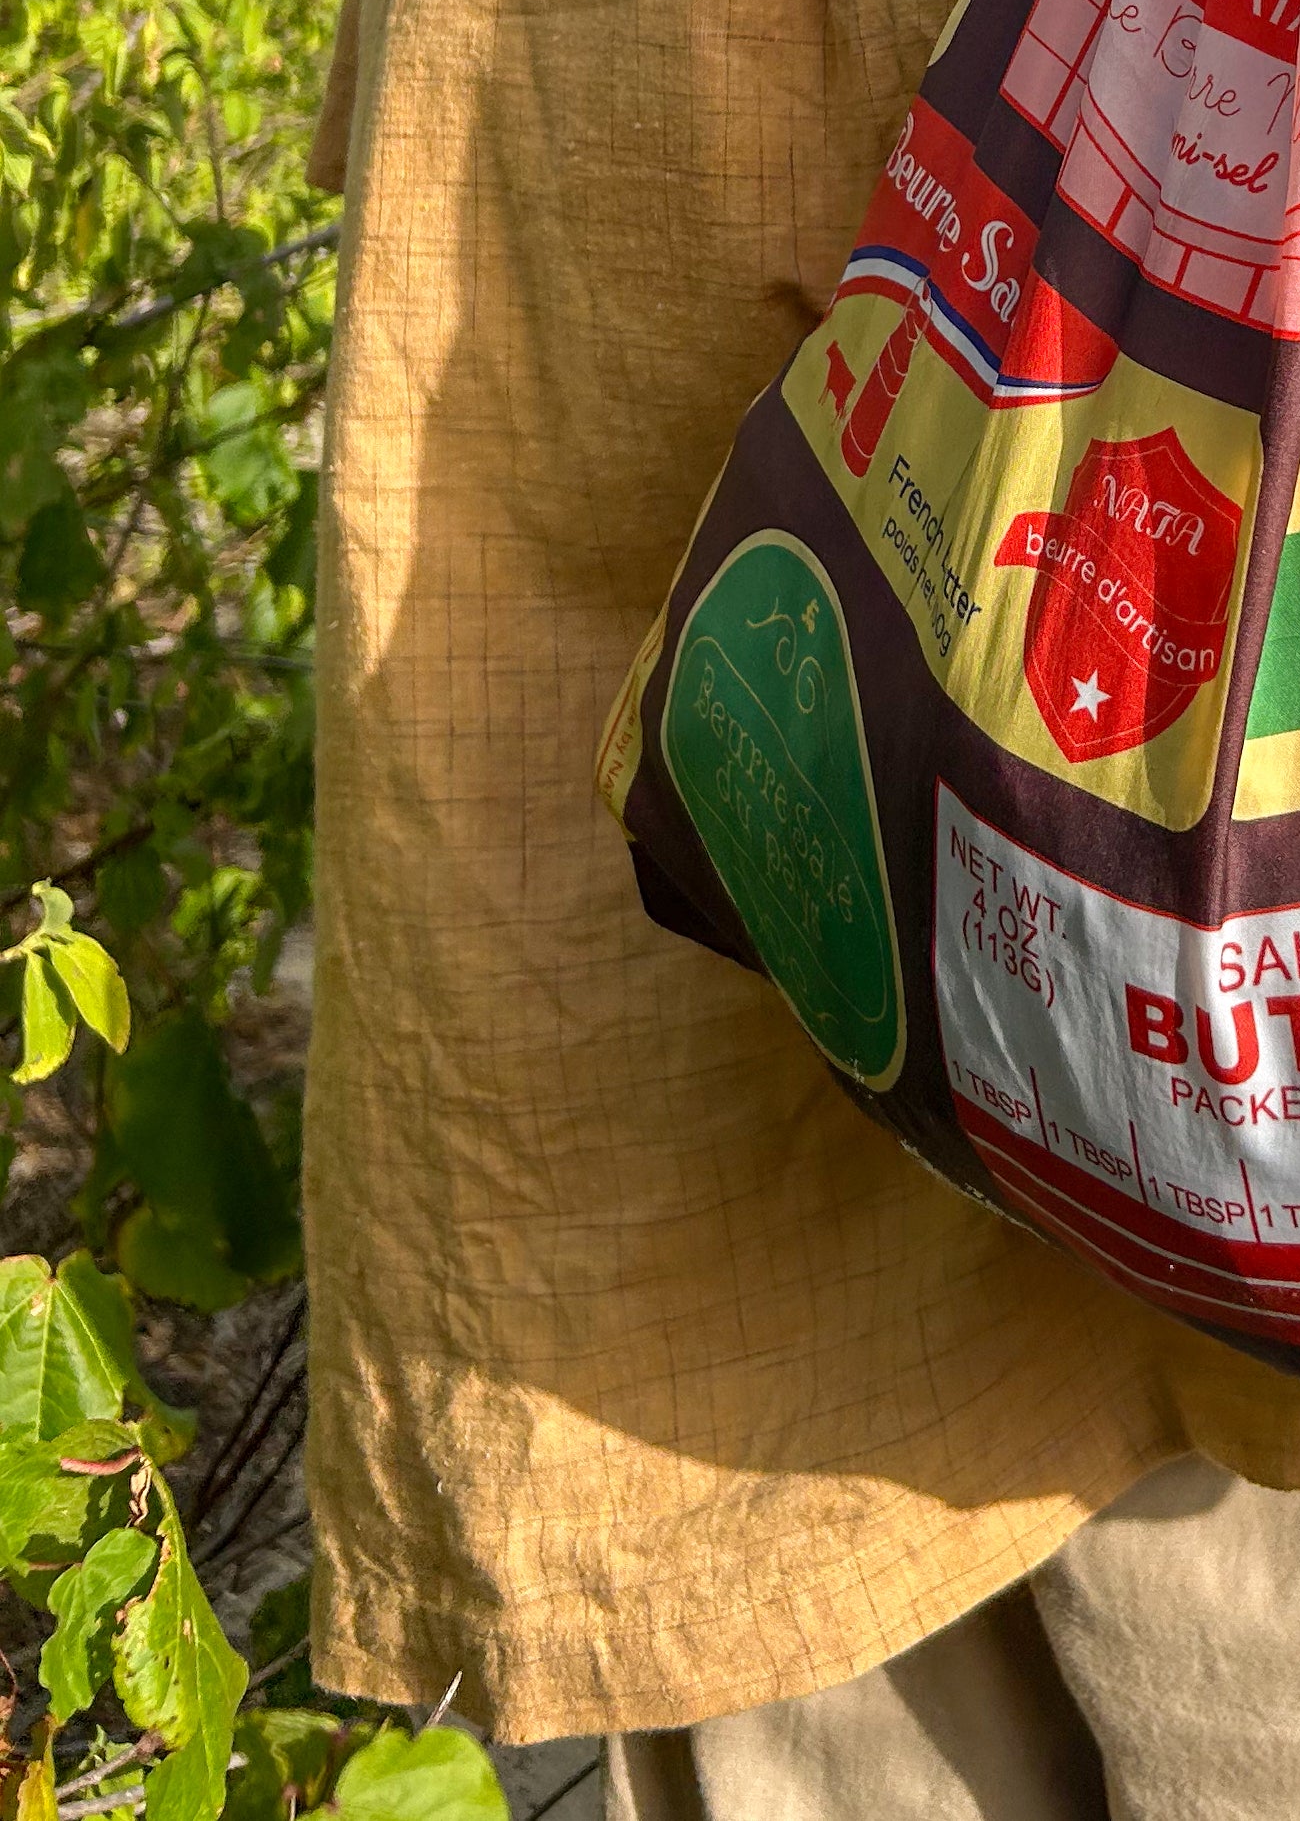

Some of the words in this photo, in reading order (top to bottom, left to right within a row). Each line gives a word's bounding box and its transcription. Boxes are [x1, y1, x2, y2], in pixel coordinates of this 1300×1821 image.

[961, 220, 1021, 329] Sa
[888, 453, 944, 556] French
[1093, 474, 1205, 556] NATA
[881, 517, 920, 574] poids
[1098, 578, 1214, 672] d'artisan
[952, 826, 1003, 893] NET
[1012, 877, 1066, 939] WT.
[963, 910, 1054, 1008] (113G)
[973, 888, 986, 919] 4
[998, 906, 1039, 959] OZ
[952, 1061, 962, 1082] 1
[966, 1068, 1032, 1123] TBSP
[1049, 1122, 1060, 1144] 1
[1065, 1128, 1133, 1181] TBSP
[1149, 1176, 1160, 1200] 1
[1166, 1182, 1245, 1225] TBSP
[1259, 1206, 1274, 1227] 1
